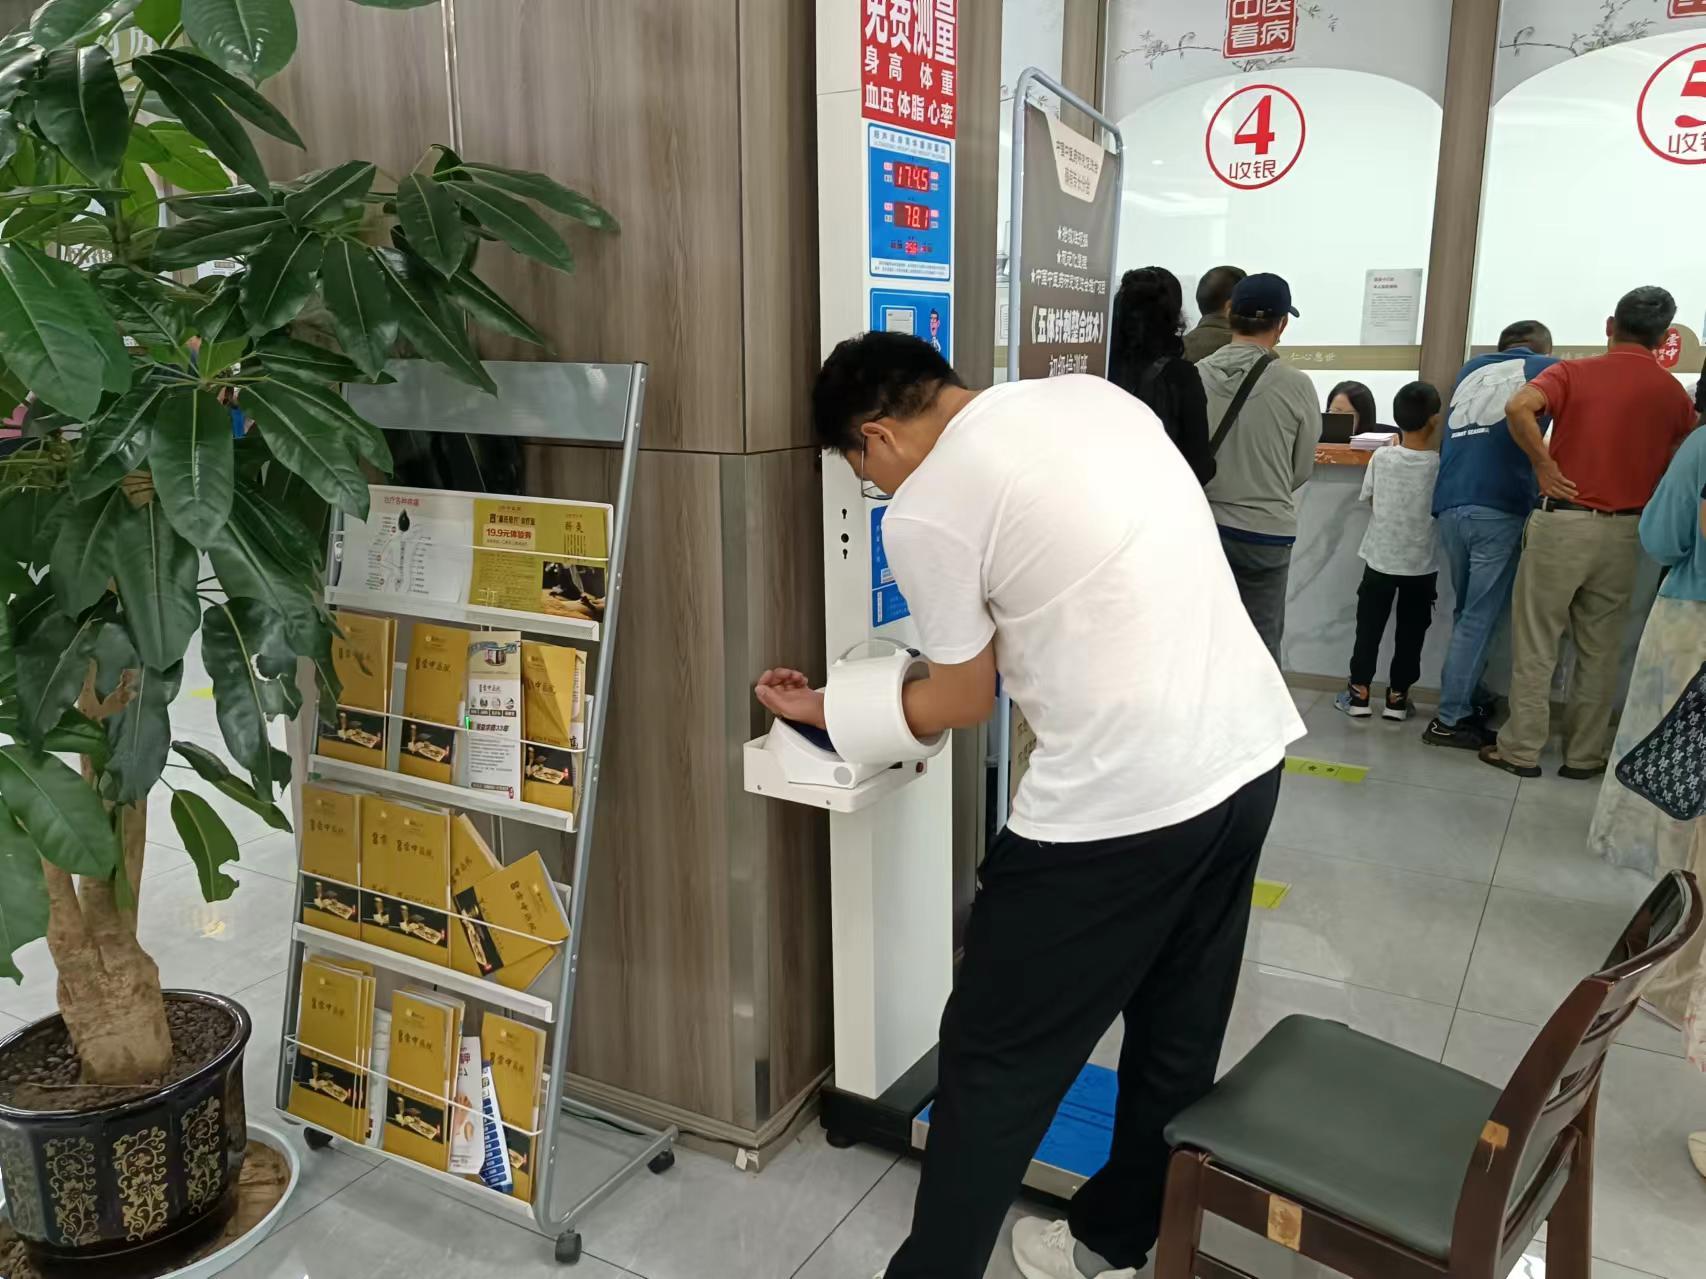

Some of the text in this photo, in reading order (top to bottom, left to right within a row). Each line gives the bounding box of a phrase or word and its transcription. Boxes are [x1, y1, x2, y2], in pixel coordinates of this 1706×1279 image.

[1232, 0, 1291, 19] 中医
[865, 0, 955, 65] 免费测量
[1231, 20, 1290, 49] 看病
[864, 44, 954, 96] 身高 体重
[865, 82, 954, 129] 血压 体脂 心率
[1234, 94, 1275, 155] 4
[1668, 132, 1706, 155] 收
[1229, 160, 1276, 180] 收银
